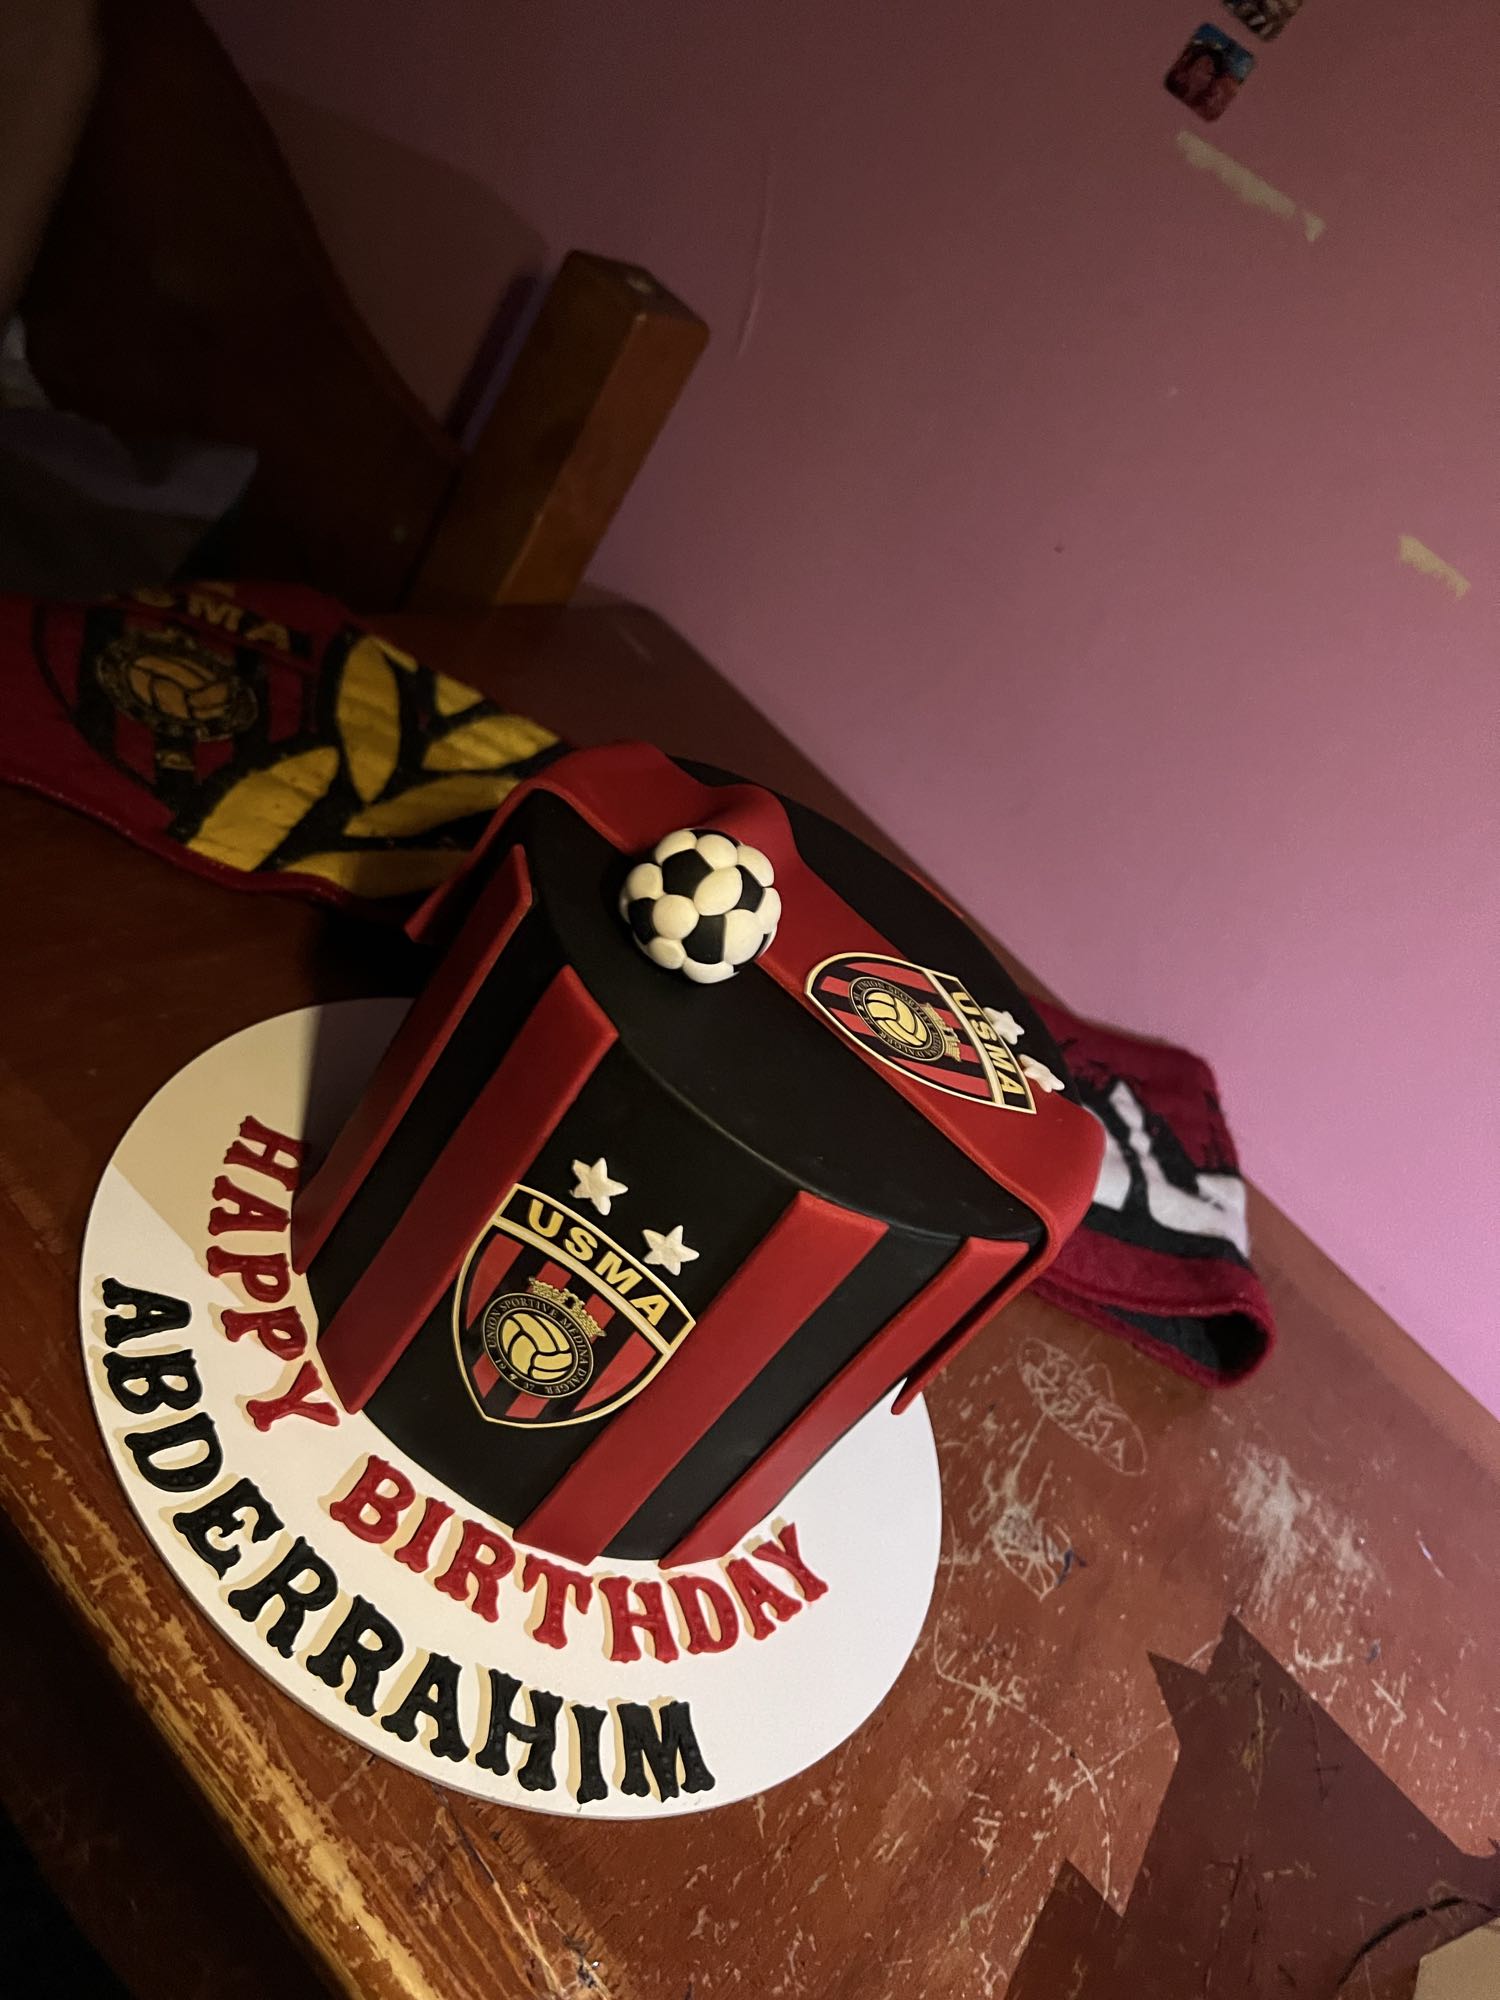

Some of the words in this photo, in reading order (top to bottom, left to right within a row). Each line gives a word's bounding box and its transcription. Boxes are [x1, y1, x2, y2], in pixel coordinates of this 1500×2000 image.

[951, 991, 1026, 1095] USMA
[206, 1115, 340, 1432] HAPPY
[486, 1309, 501, 1348] UNION
[500, 1297, 558, 1317] SPORTIVE
[560, 1318, 589, 1364] MEDINA
[528, 1198, 670, 1326] USMA
[102, 1277, 716, 1804] ABDERRAHIM
[329, 1454, 829, 1664] BIRTHDAY
